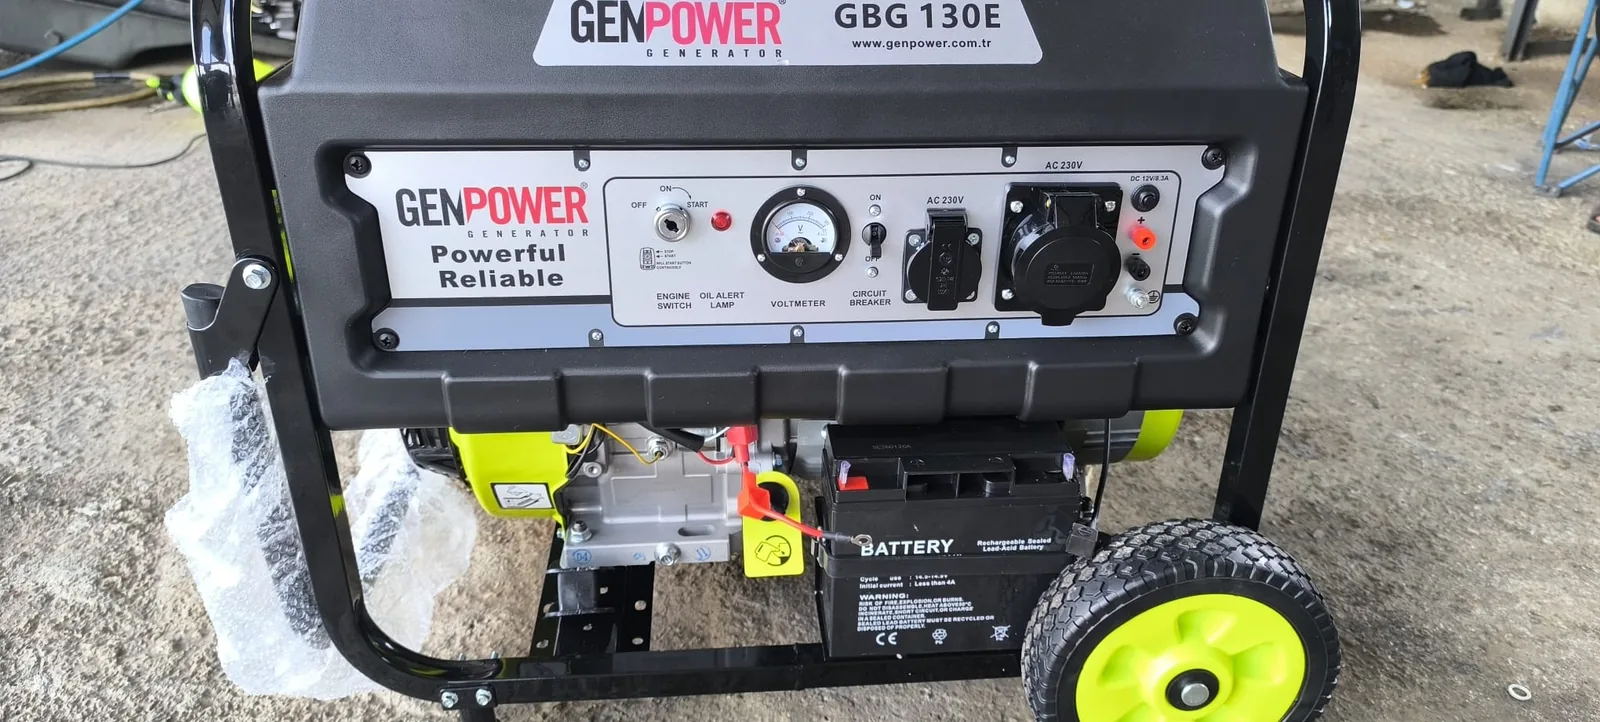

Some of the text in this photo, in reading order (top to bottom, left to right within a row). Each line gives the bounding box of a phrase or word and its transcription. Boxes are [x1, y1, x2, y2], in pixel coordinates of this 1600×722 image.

[570, 0, 782, 45] GENPOWER
[834, 2, 1002, 29] GBG 130E
[851, 38, 992, 51] www.genpower.com.tr
[646, 48, 783, 58] GENERATOR
[1045, 160, 1083, 170] AC 230V
[395, 186, 589, 227] GENPOWER
[926, 196, 965, 205] AC 230V
[467, 229, 589, 238] GENERATOR
[431, 244, 566, 263] Powerful
[439, 269, 564, 288] Reliable
[699, 292, 714, 300] OIL
[860, 538, 954, 557] BATTERY
